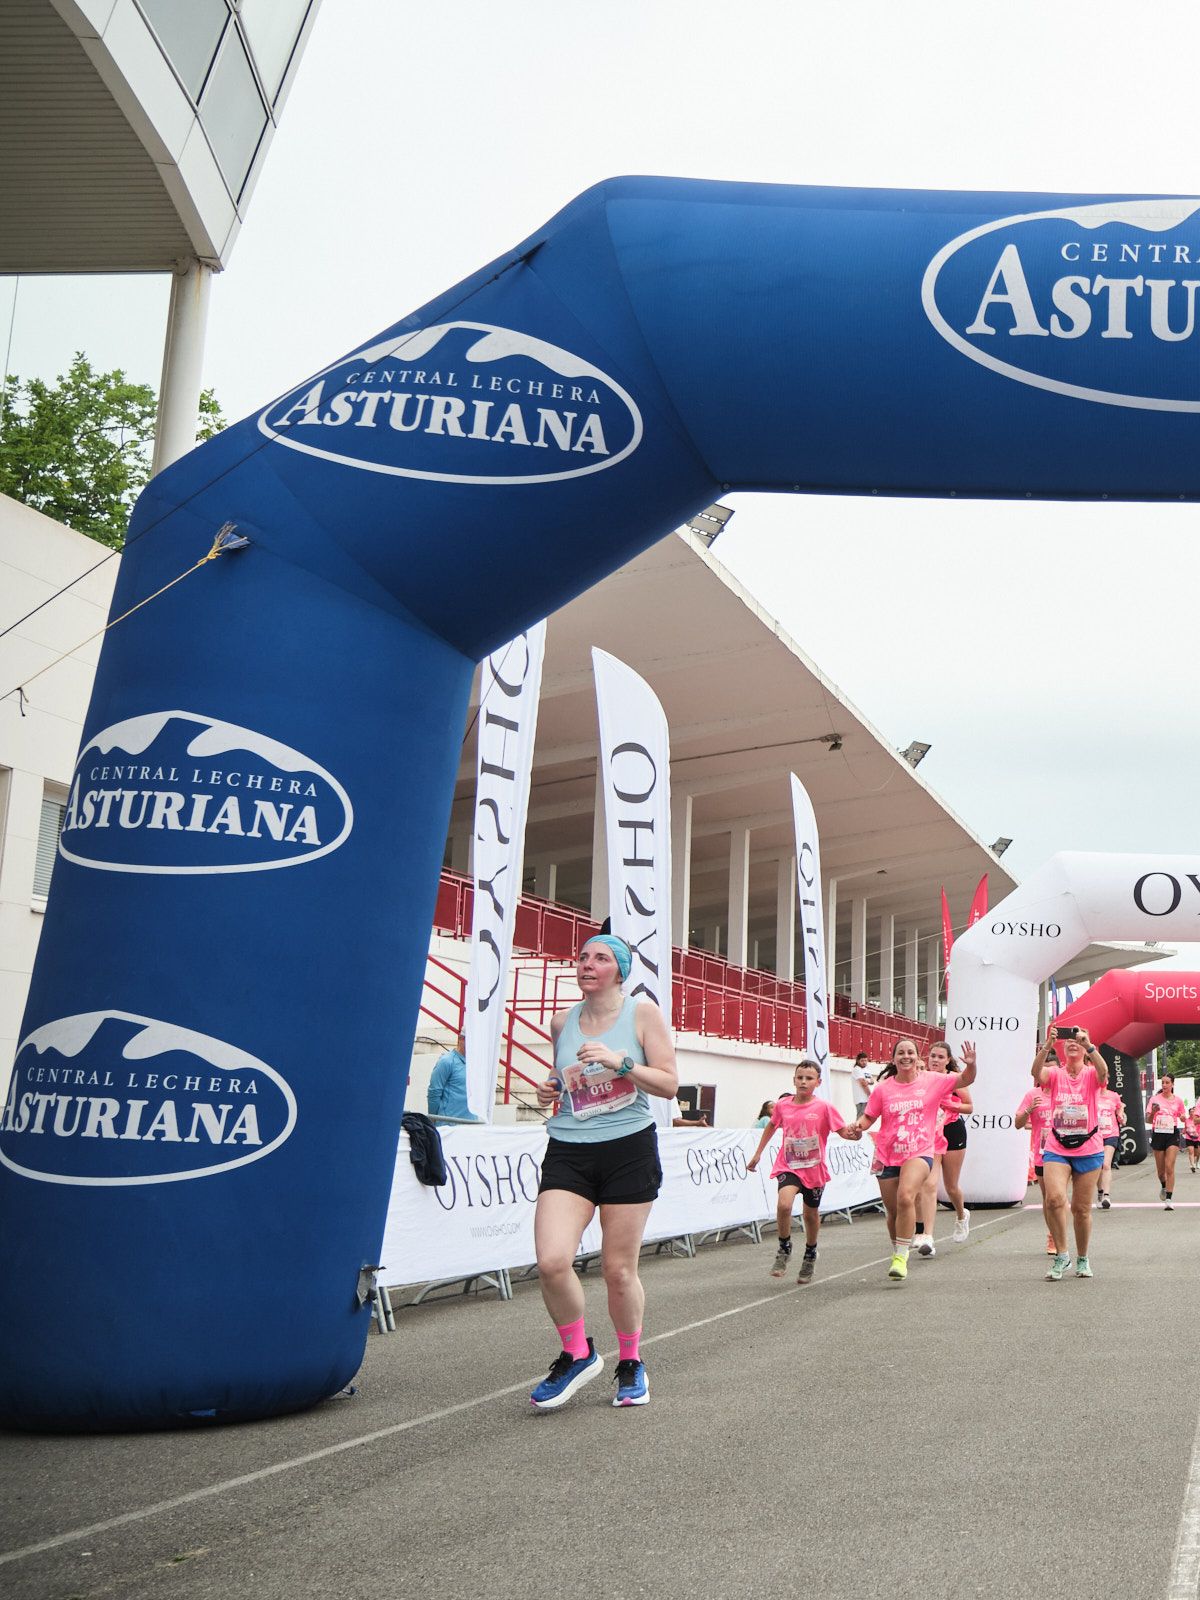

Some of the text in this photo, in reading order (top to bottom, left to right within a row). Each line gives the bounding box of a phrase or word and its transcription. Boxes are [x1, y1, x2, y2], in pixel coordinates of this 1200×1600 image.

[346, 370, 601, 404] CENTRAL LECHERA
[273, 379, 610, 455] ASTURIANA
[90, 765, 318, 798] CENTRAL LECHERA
[61, 773, 321, 846] ASTURIANA
[991, 922, 1061, 938] OYSHO
[1144, 983, 1198, 1002] Sports
[954, 1016, 1019, 1031] OYSHO
[27, 1066, 259, 1095] CENTRAL LECHERA
[1114, 1055, 1124, 1088] Deporte
[590, 1081, 614, 1096] 016
[0, 1069, 263, 1146] ASTURIANA
[960, 1114, 1012, 1130] YSHO
[434, 1153, 541, 1211] OYSHO
